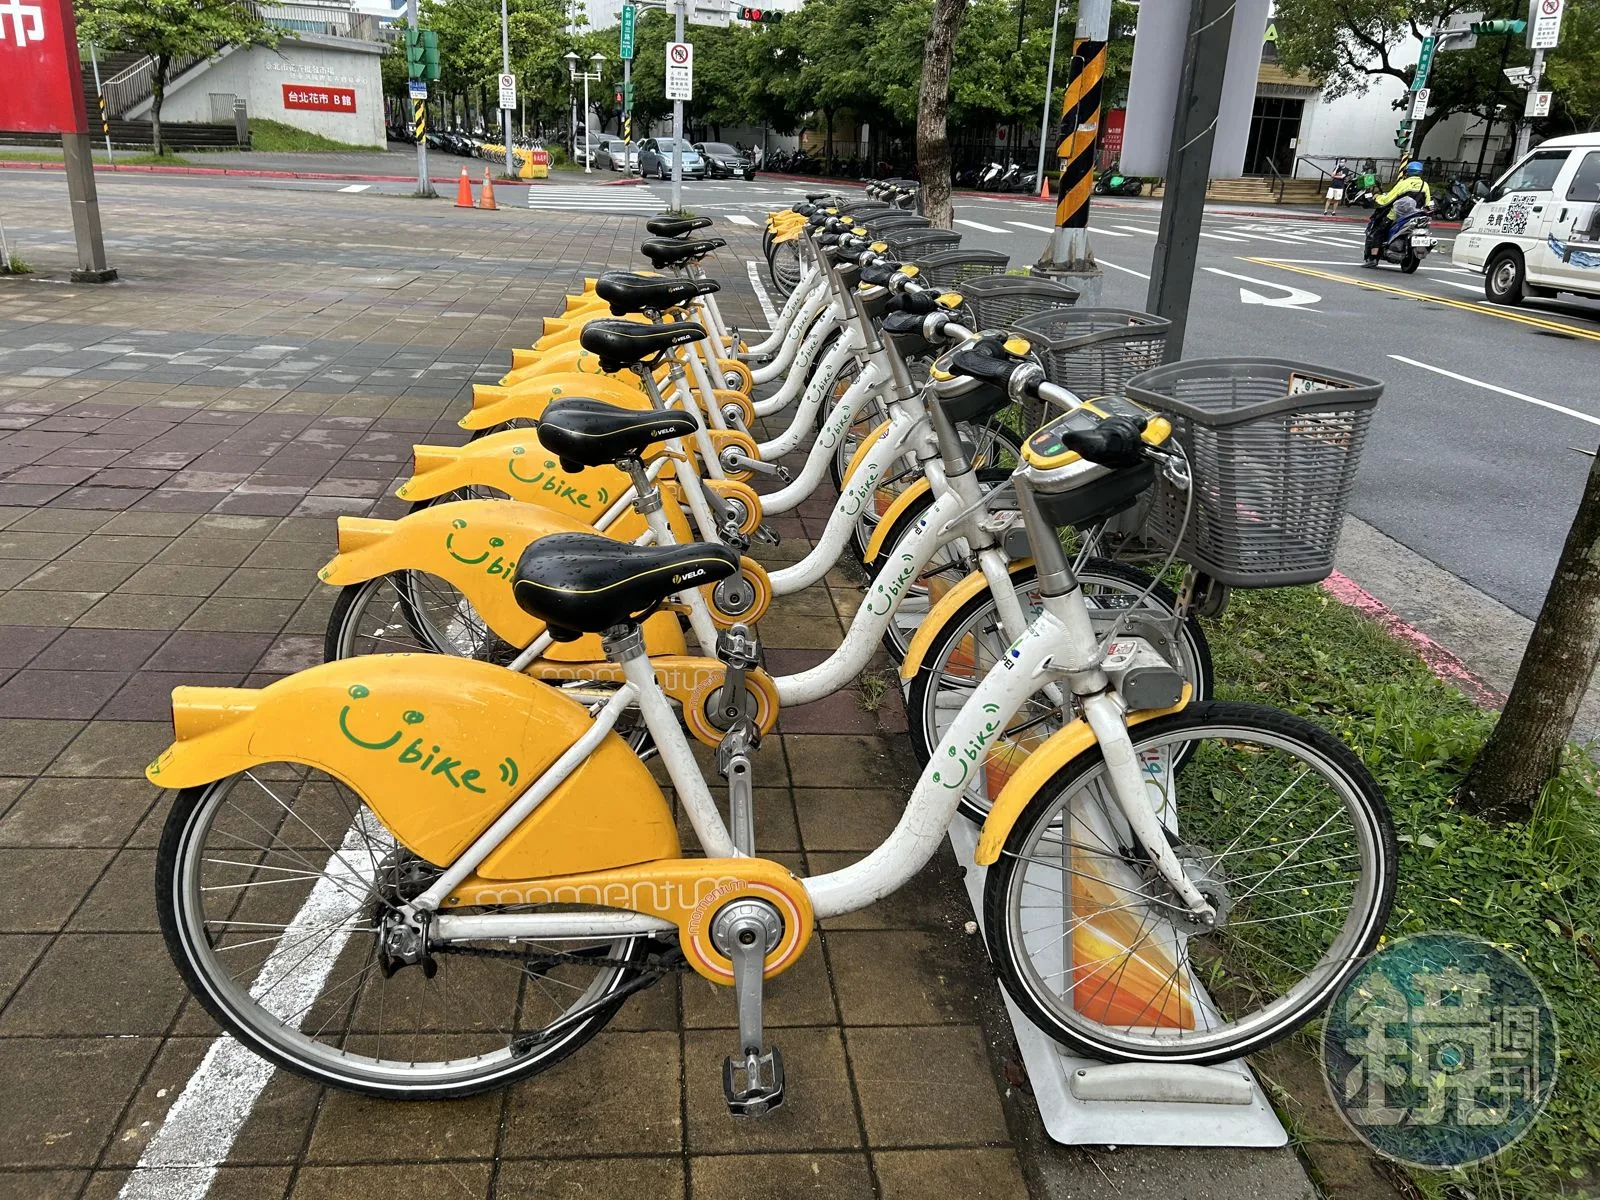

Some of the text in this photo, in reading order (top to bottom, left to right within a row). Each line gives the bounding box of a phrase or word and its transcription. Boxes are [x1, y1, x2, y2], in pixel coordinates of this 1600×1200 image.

[288, 91, 328, 104] 台北花市
[677, 334, 691, 342] VELO
[657, 427, 675, 435] VELO
[681, 568, 705, 581] VELO
[476, 876, 738, 911] momentum
[688, 879, 748, 935] momentum
